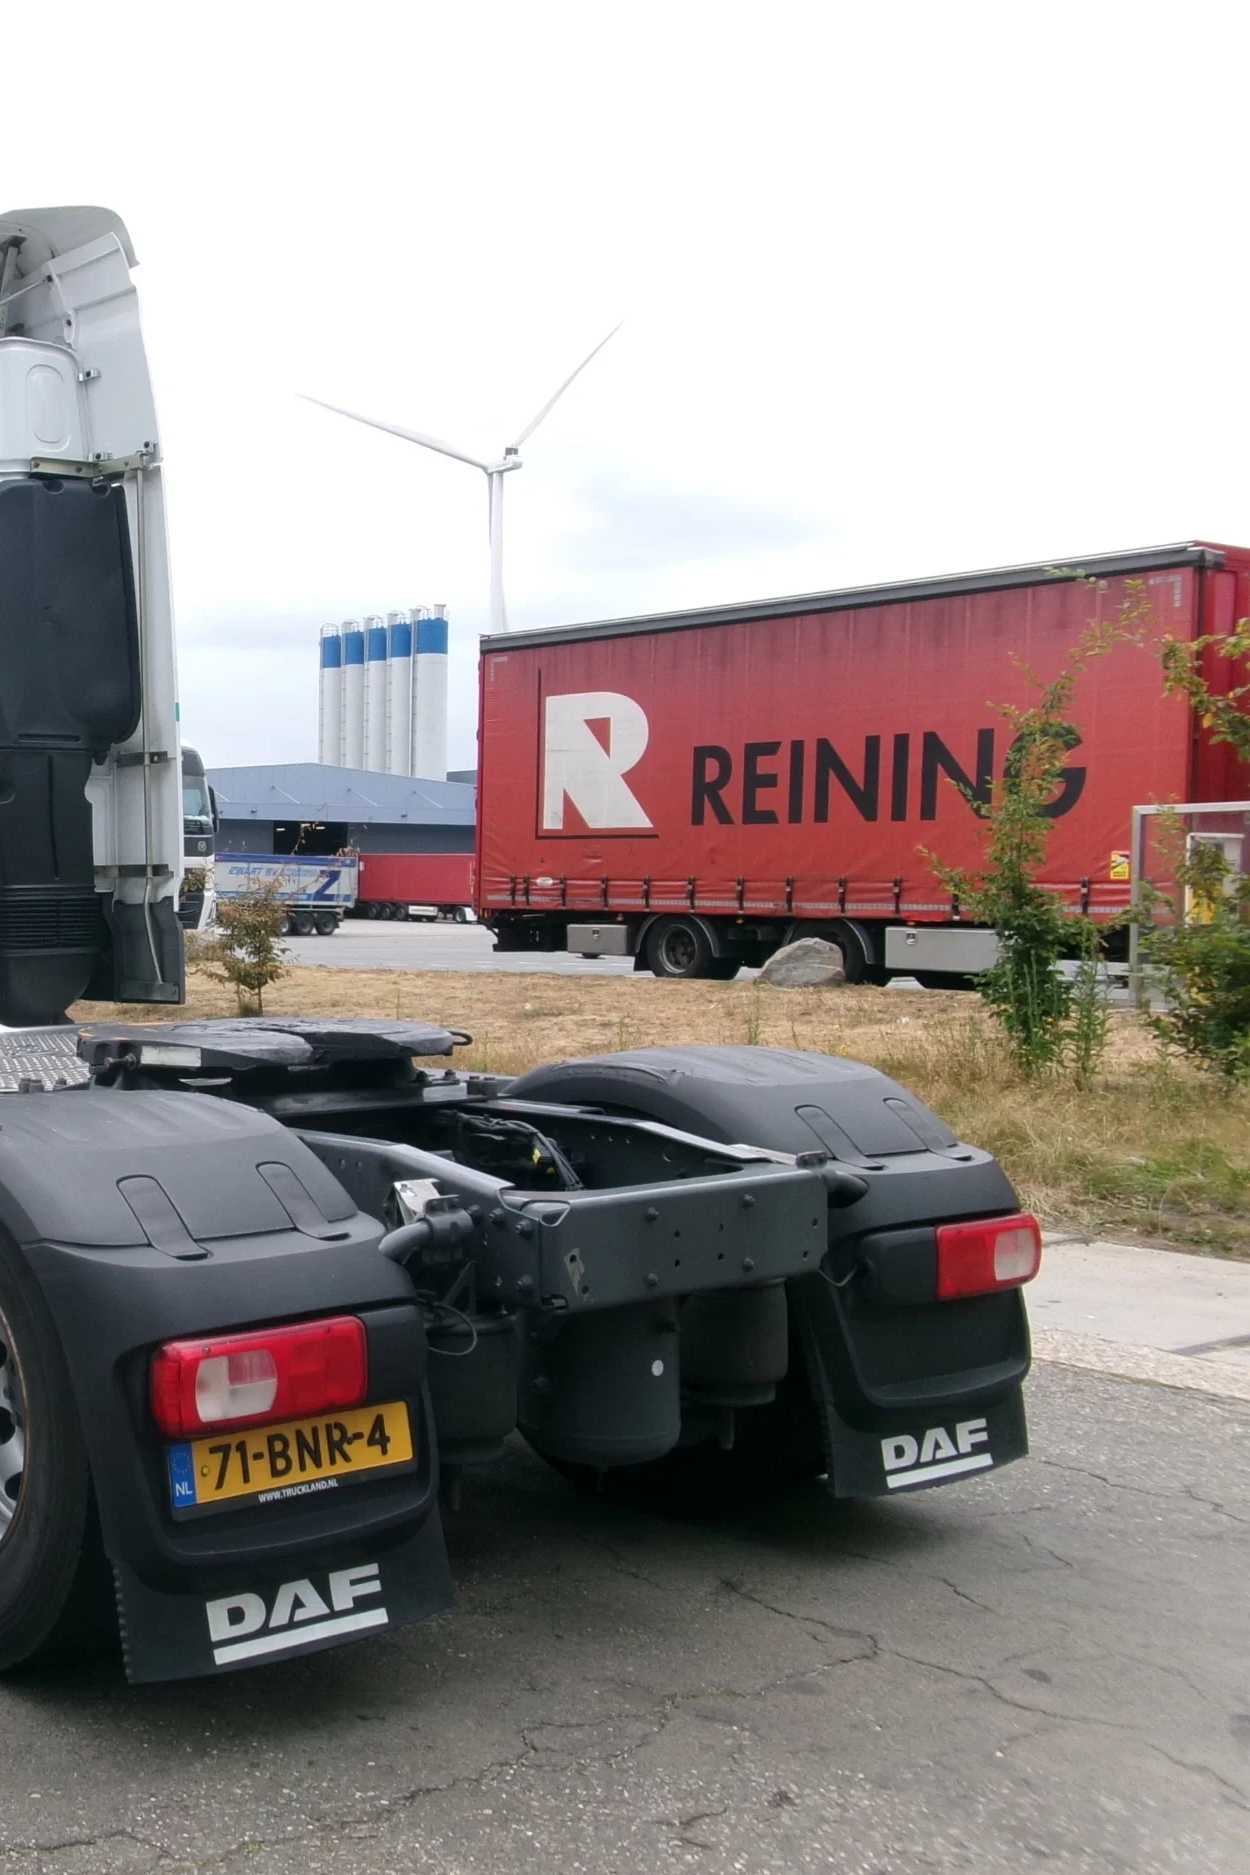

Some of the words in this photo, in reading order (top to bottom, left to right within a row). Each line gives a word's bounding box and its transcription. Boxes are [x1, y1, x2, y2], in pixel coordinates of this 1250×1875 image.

[543, 691, 654, 829] R
[691, 723, 1087, 826] REINING
[209, 1413, 391, 1490] 71-BNR-4
[881, 1418, 988, 1471] DAF
[175, 1482, 193, 1497] NL
[258, 1478, 339, 1504] WWW.TRUCKLAND.NL
[205, 1562, 382, 1642] DAF
